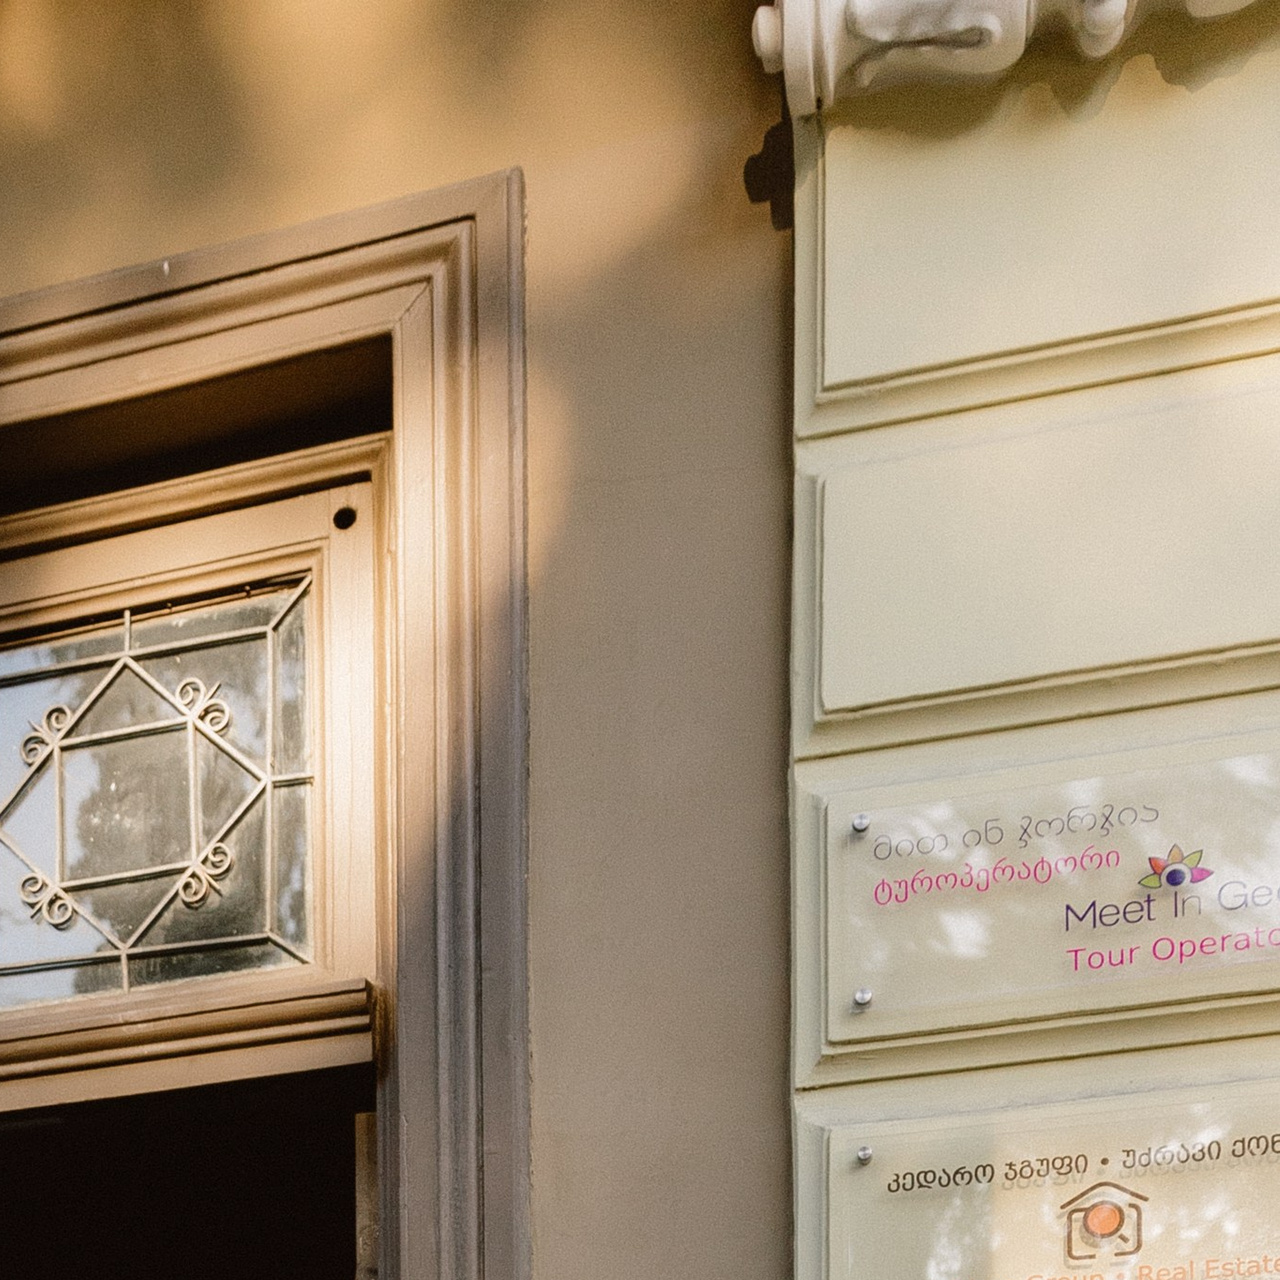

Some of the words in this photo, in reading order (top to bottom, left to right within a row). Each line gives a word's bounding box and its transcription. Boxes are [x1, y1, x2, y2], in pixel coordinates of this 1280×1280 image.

[1065, 893, 1156, 932] Meet
[1173, 890, 1202, 918] In
[1217, 880, 1280, 911] Ge
[1066, 945, 1142, 972] Tour
[887, 1163, 995, 1193] კედარო
[1004, 1154, 1089, 1181] ჯგუფი
